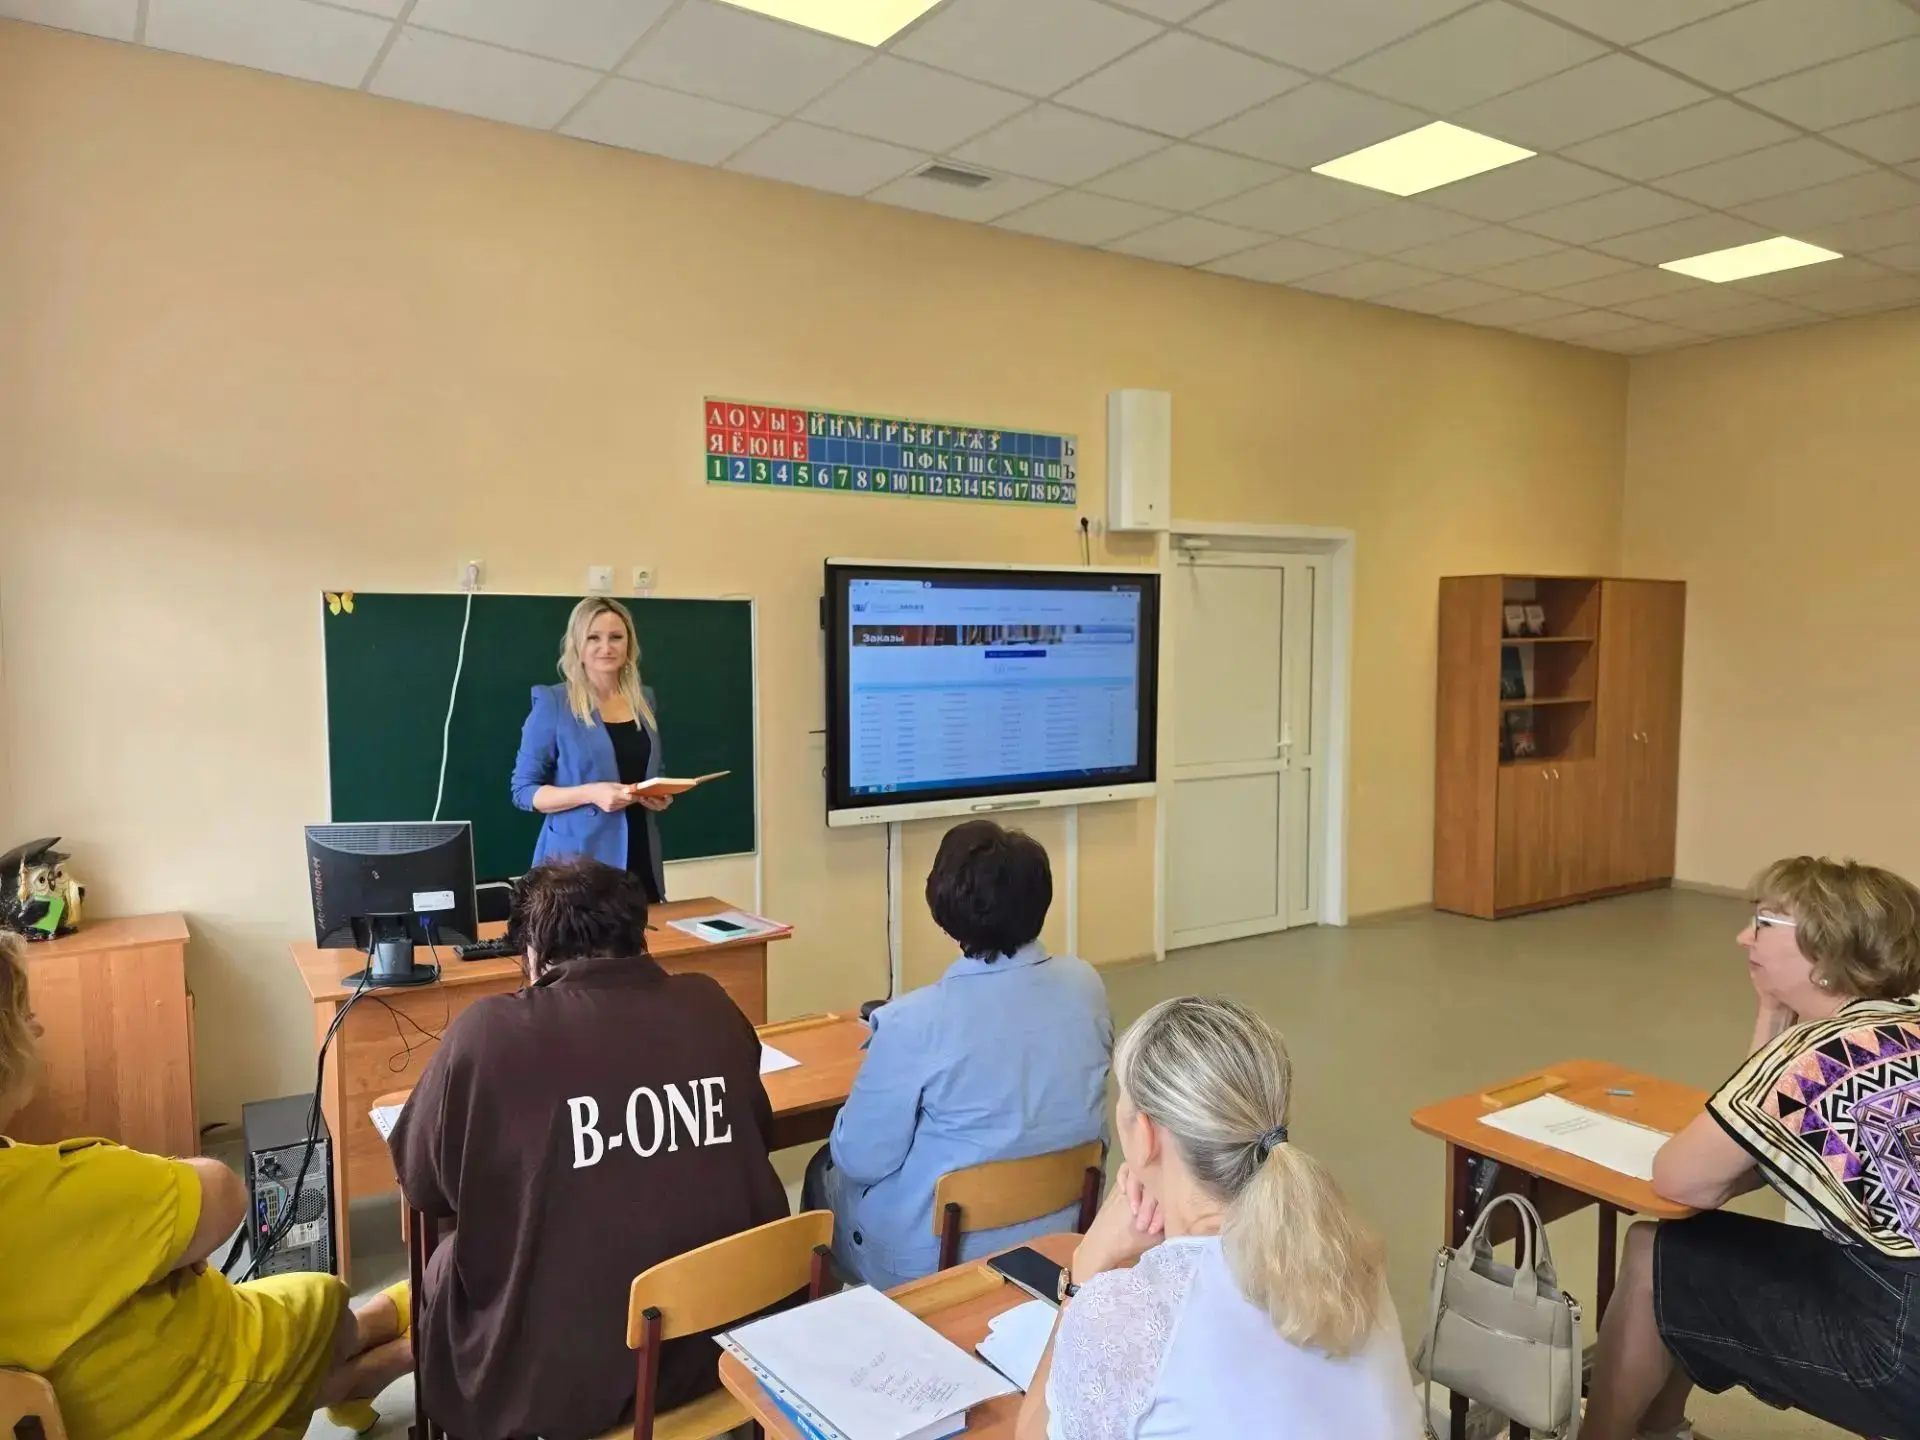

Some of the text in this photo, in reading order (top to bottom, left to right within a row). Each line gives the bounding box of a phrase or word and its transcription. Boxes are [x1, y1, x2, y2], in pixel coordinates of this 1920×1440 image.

[709, 408, 724, 426] А
[729, 408, 745, 427] О
[751, 410, 765, 429] У
[771, 413, 785, 432] Ы
[792, 415, 804, 433] Э
[830, 419, 843, 437] Н
[886, 425, 897, 441] Р
[903, 426, 915, 444] Б
[921, 428, 932, 445] В
[968, 432, 984, 449] Ж
[1064, 441, 1075, 457] Ь
[710, 434, 724, 452] Я
[732, 432, 745, 453] Ё
[751, 437, 768, 456] Ю
[772, 439, 785, 457] И
[793, 441, 805, 459] Е
[903, 451, 914, 468] П
[919, 452, 933, 469] Ф
[938, 454, 948, 471] К
[954, 455, 965, 472] Т
[969, 456, 983, 473] Ш
[987, 457, 998, 474] С
[1003, 460, 1014, 476] Х
[1019, 461, 1029, 477] Ч
[1064, 464, 1075, 480] Ъ
[714, 460, 1076, 501] 1 2 3 4 5 6 7 8 9 10 11 12 13 14 15 16 17 18 19 20
[862, 633, 905, 643] Заказы
[567, 1076, 732, 1169] B-ONE
